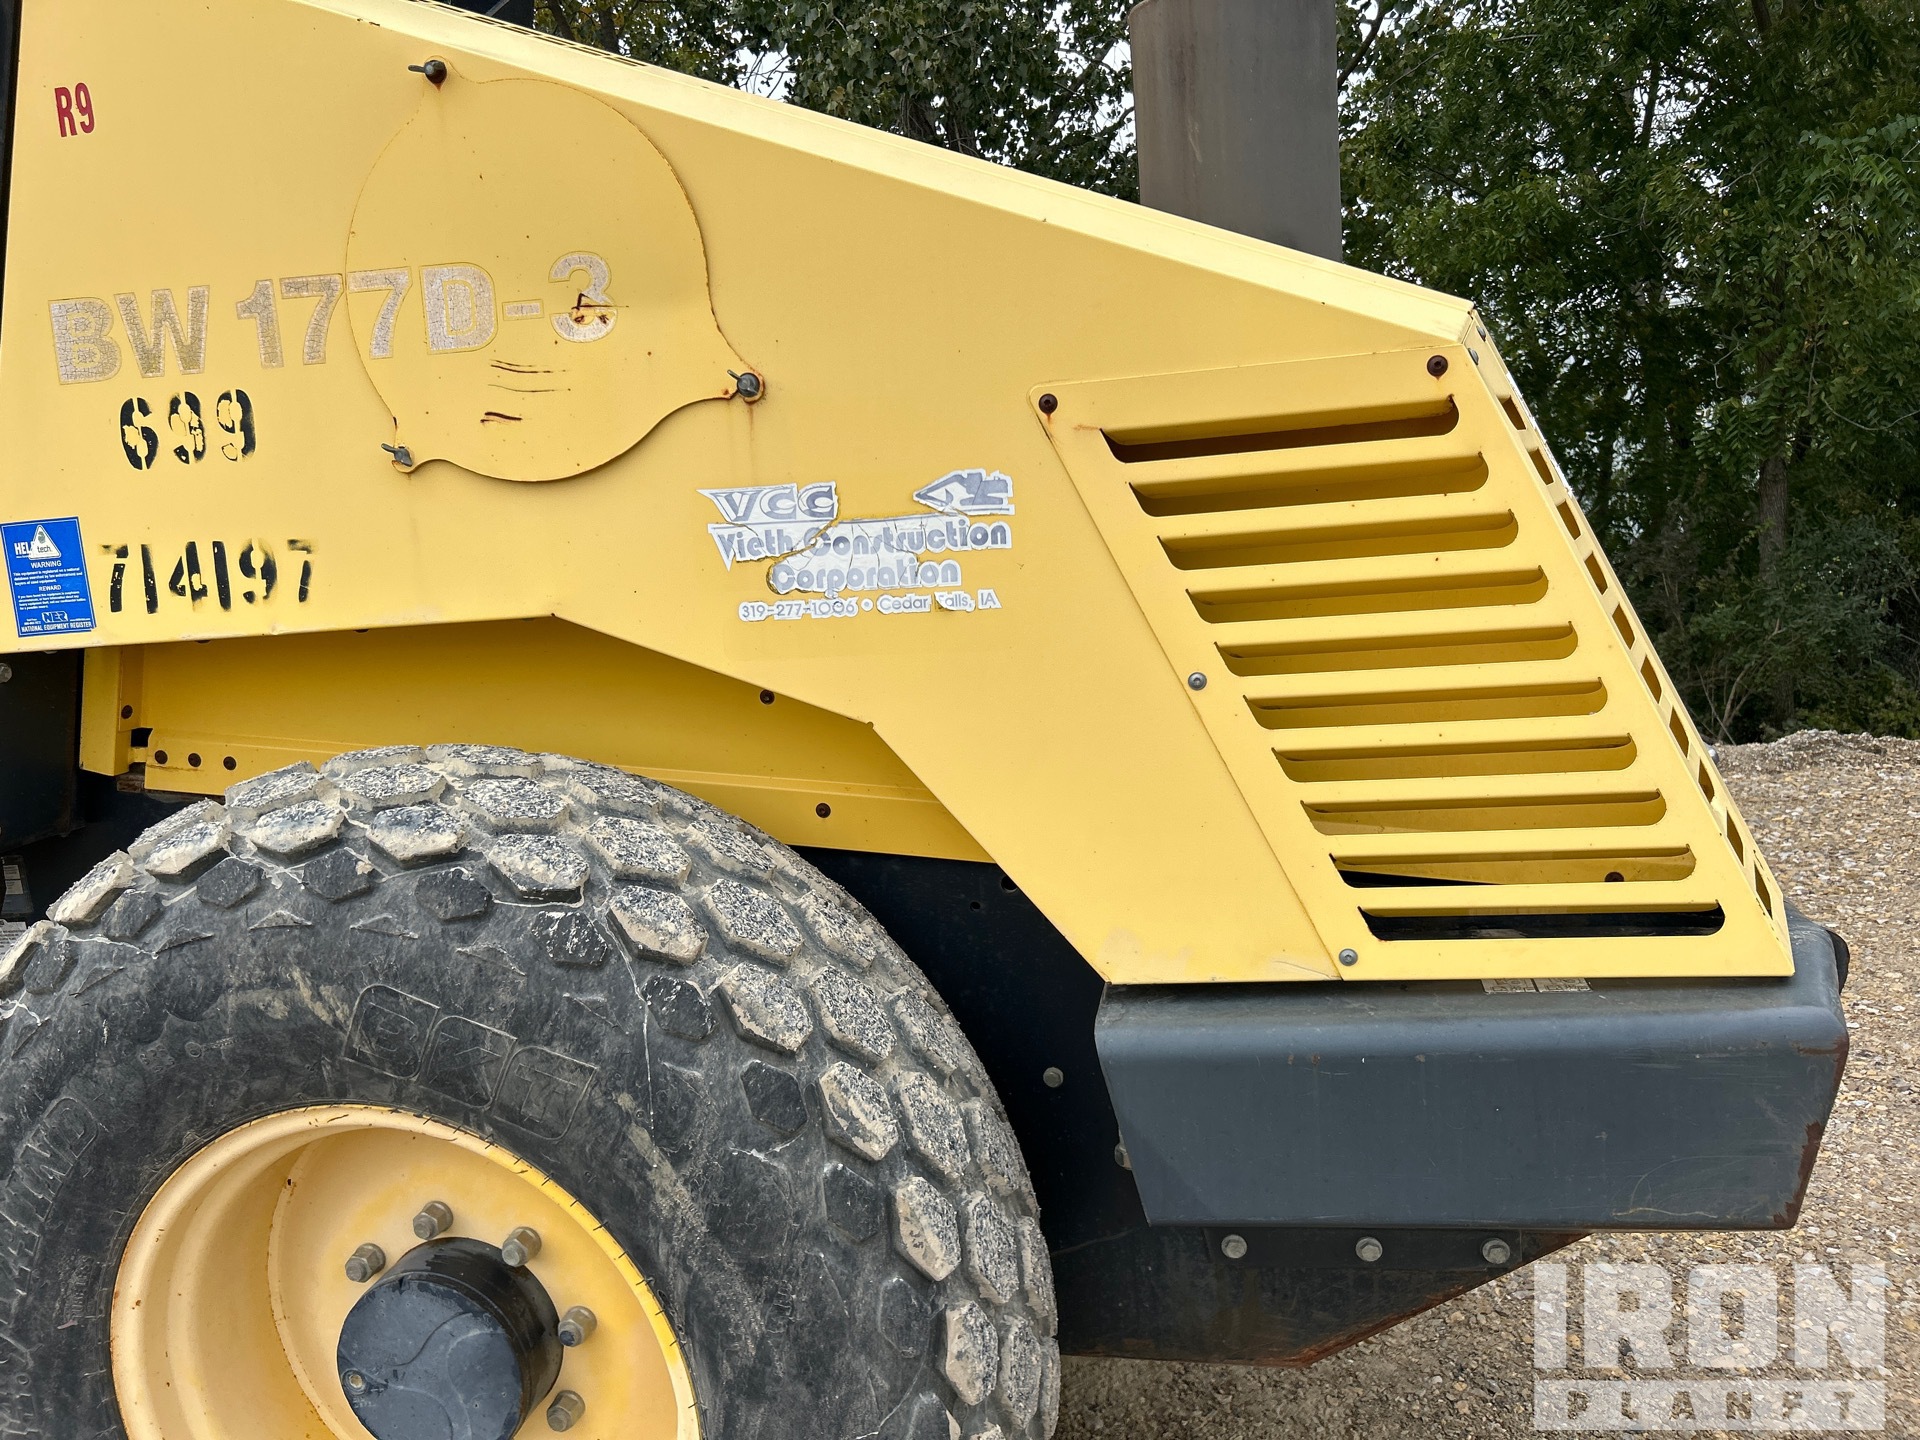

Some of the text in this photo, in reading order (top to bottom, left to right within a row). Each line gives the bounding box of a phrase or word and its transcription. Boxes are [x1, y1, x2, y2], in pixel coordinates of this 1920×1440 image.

[54, 82, 95, 137] R9
[48, 284, 210, 385] BW
[709, 485, 836, 522] VCC
[717, 518, 1007, 559] Vieth Construction
[30, 560, 62, 569] WARNING
[773, 557, 958, 597] Corporation
[879, 595, 929, 611] Cedar
[980, 591, 996, 606] IA
